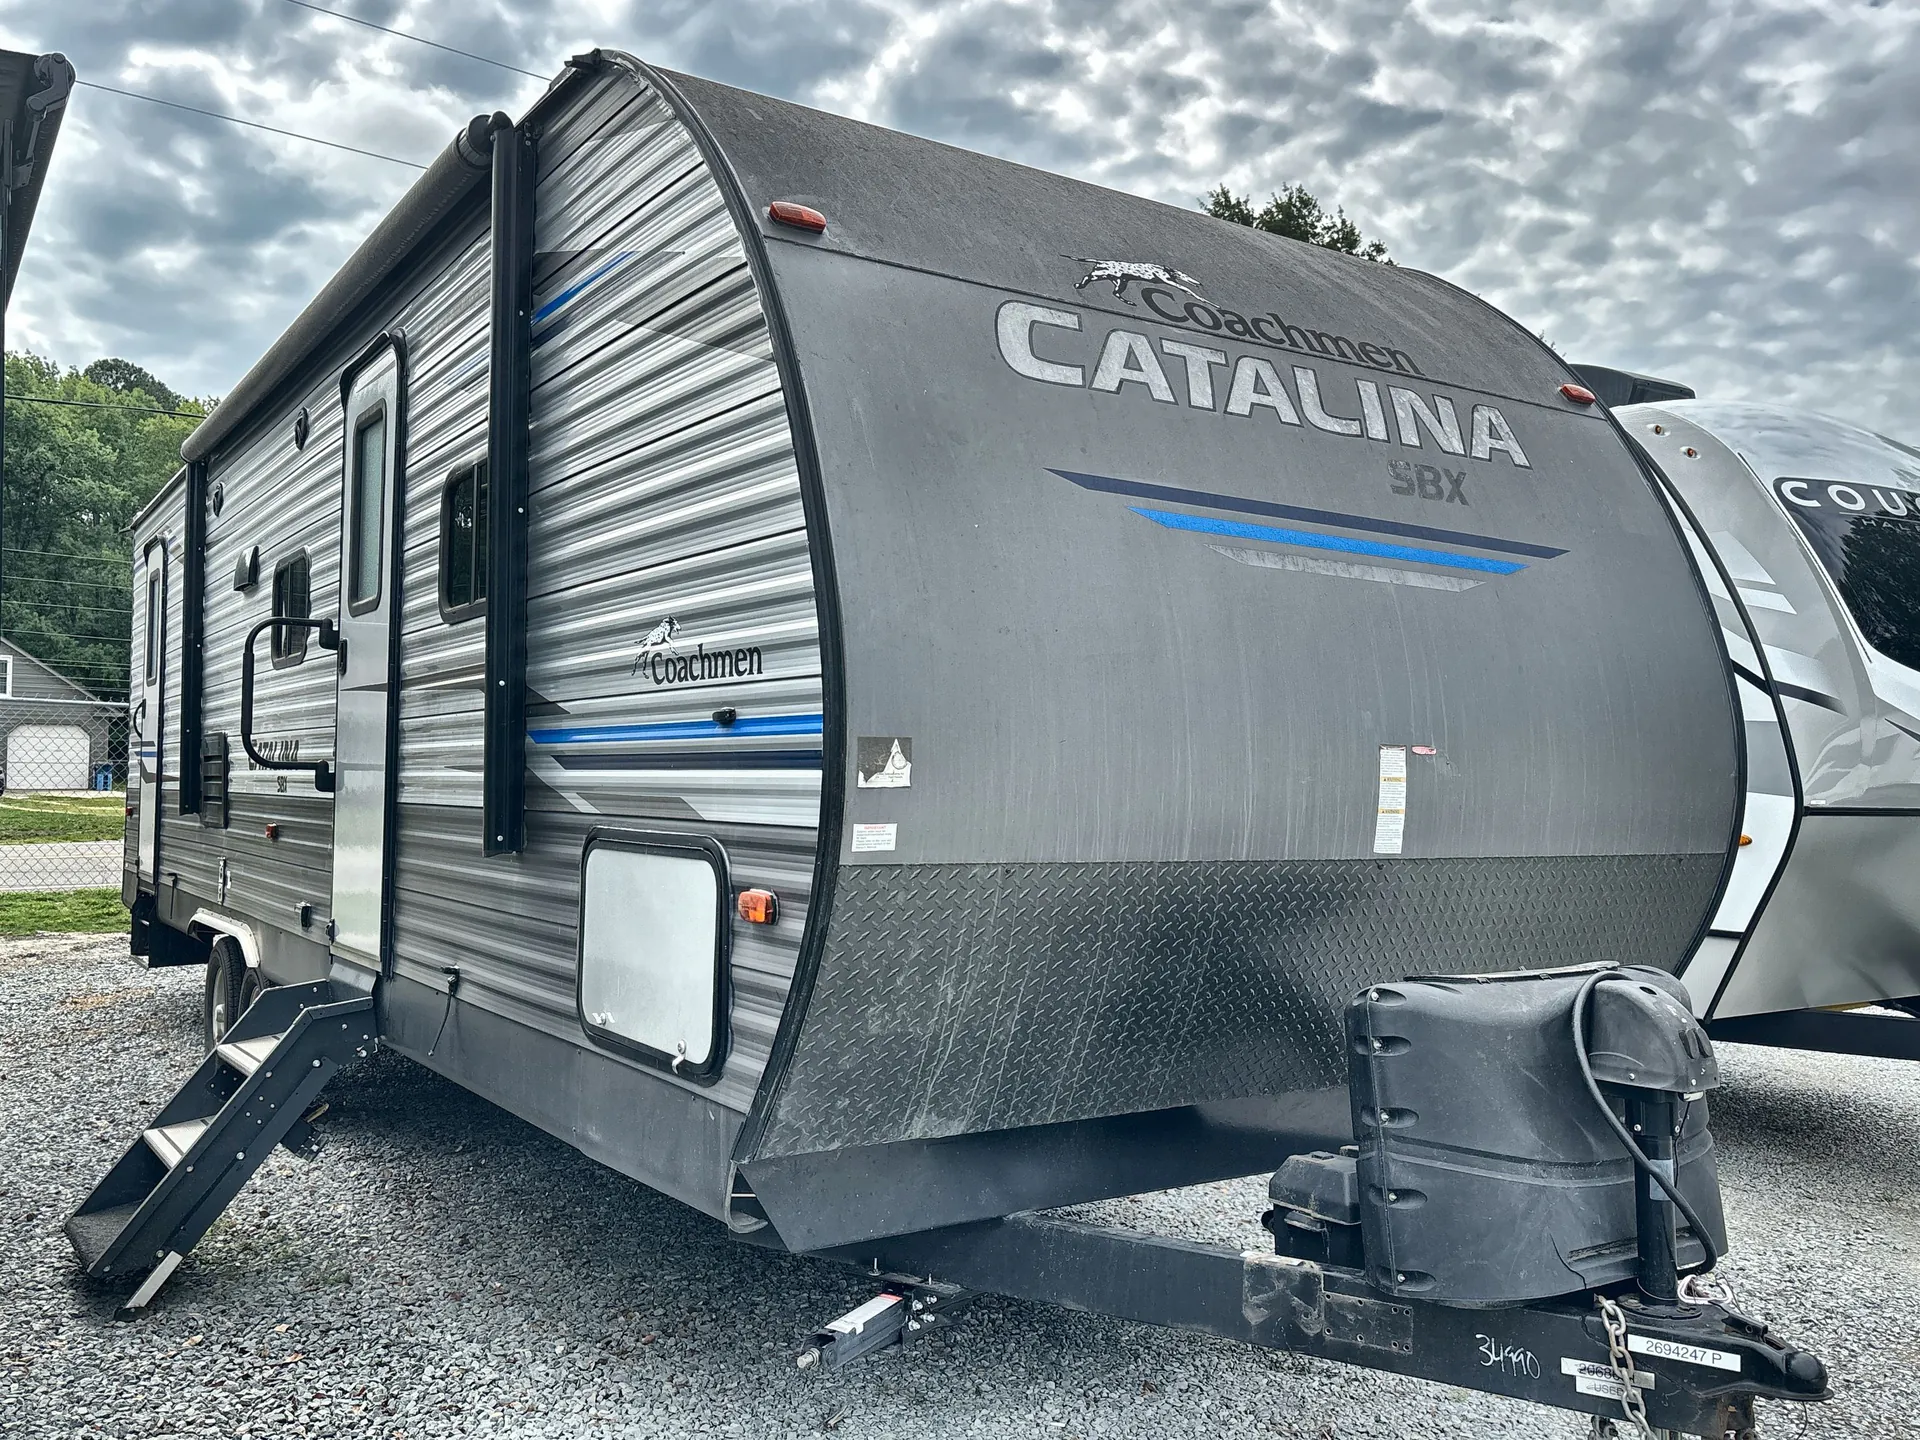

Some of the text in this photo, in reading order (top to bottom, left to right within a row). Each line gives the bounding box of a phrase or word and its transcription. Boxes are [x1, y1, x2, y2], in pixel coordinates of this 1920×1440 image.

[1141, 287, 1424, 376] Coachmen
[995, 299, 1533, 470] CATALINA
[1387, 459, 1470, 506] SBX
[651, 643, 763, 685] Coachmen
[277, 775, 288, 793] SBX
[1645, 1340, 1722, 1364] 2694247 P
